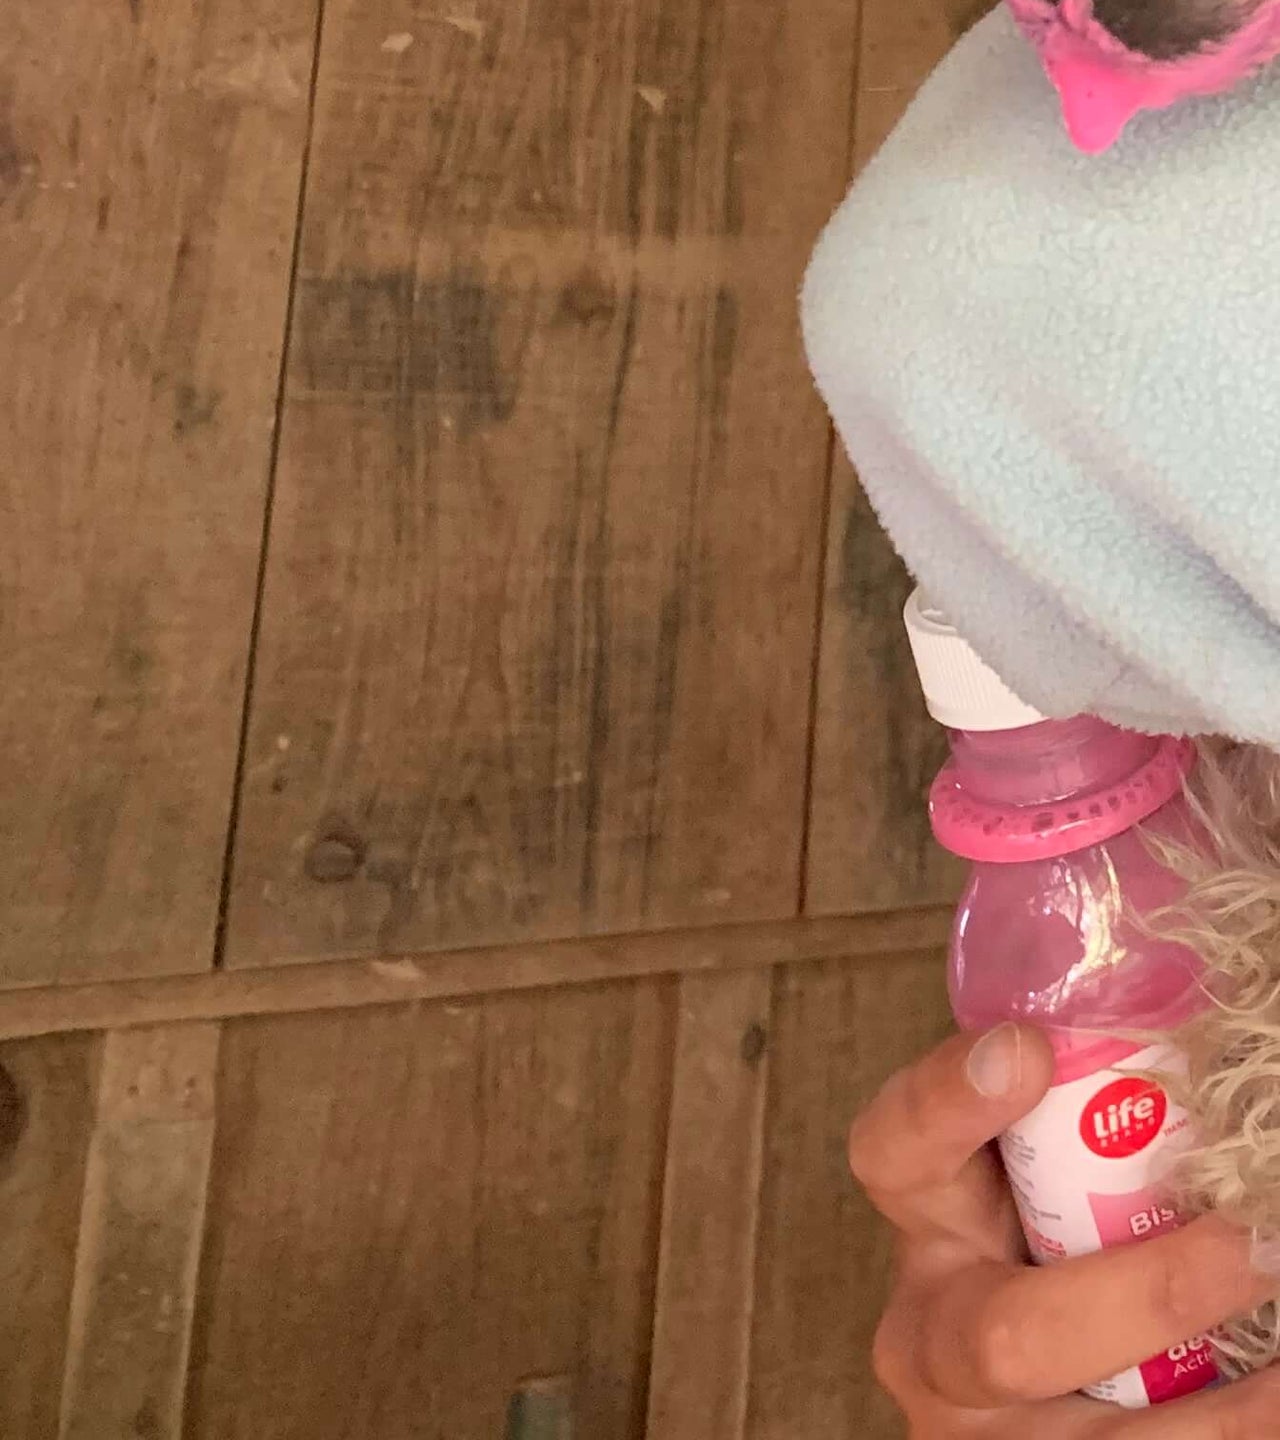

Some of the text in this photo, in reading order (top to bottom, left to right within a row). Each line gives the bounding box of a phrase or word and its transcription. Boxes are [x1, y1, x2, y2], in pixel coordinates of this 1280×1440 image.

[1093, 1096, 1155, 1139] Life
[1129, 1205, 1176, 1236] Bis
[1173, 1348, 1212, 1379] Acti
